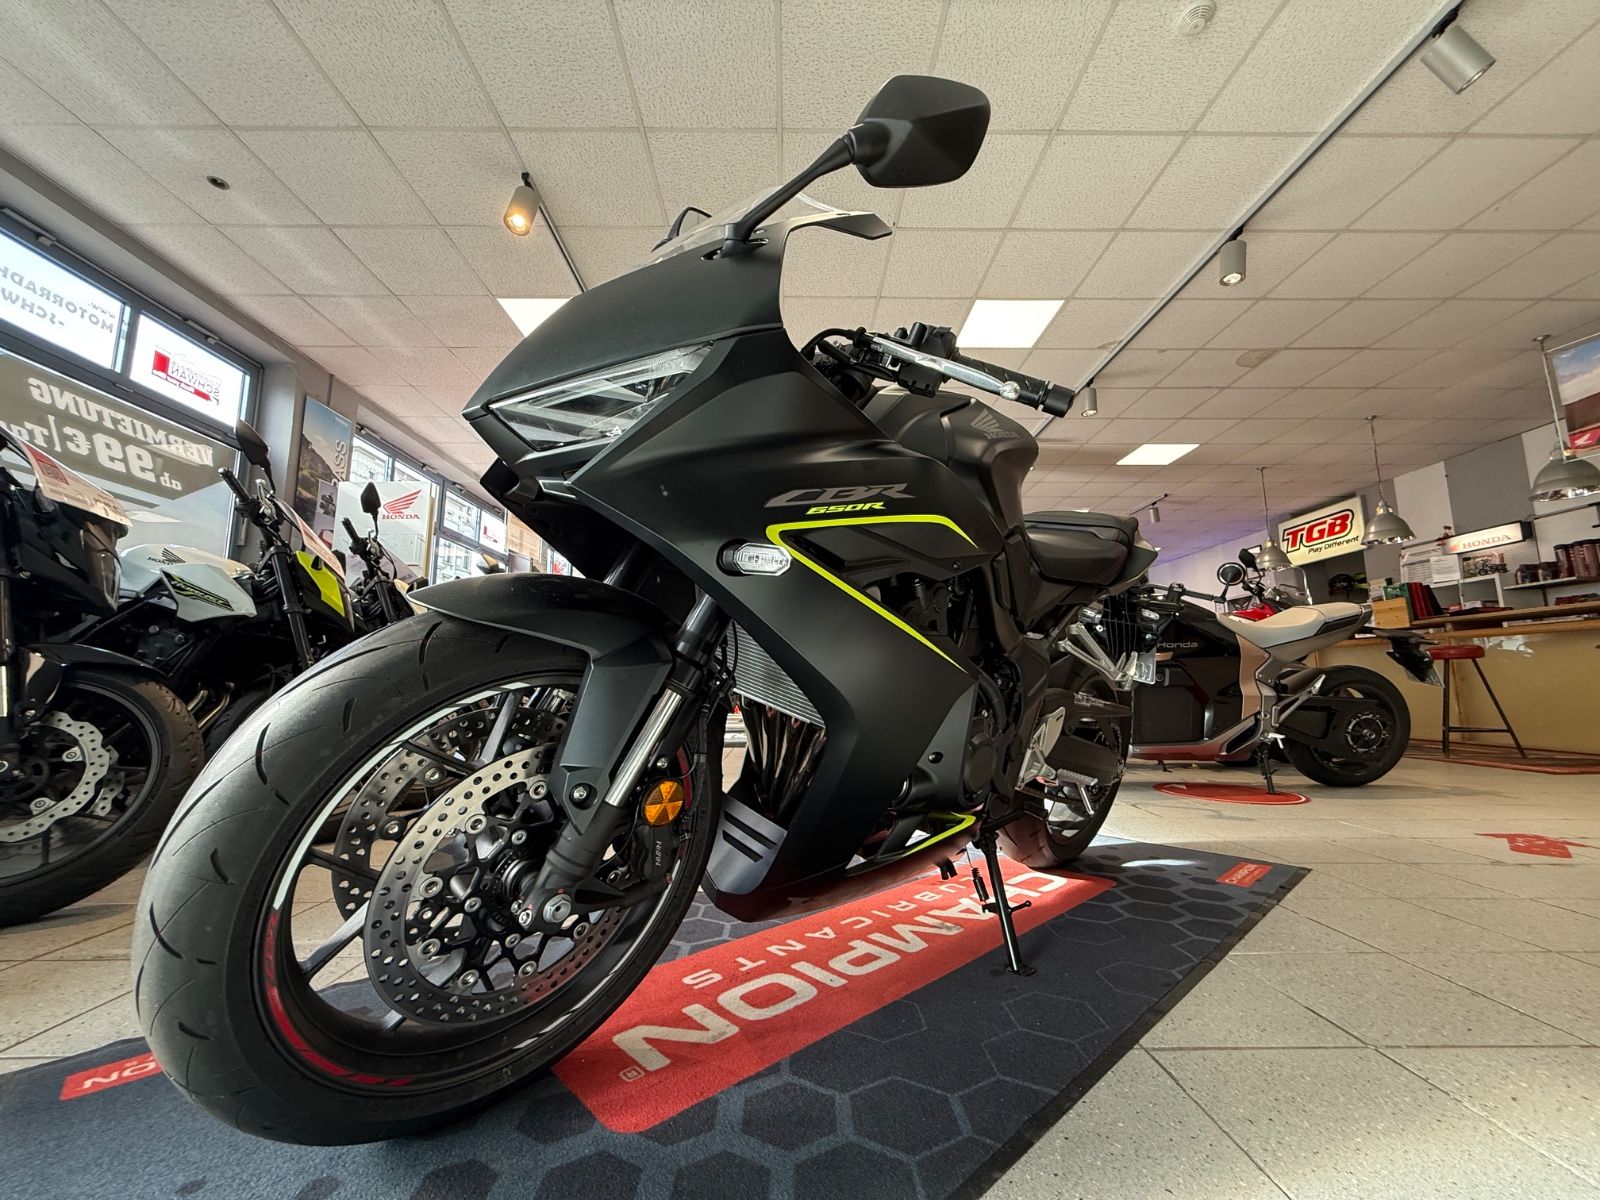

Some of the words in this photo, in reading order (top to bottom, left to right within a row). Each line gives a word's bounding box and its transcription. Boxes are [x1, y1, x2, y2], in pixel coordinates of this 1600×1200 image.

[764, 483, 915, 508] CBR
[805, 501, 887, 515] 650R
[1284, 510, 1352, 551] TGB
[1308, 546, 1323, 555] Play
[1324, 536, 1359, 550] Different
[1462, 534, 1511, 550] HONDA
[612, 871, 1068, 1072] CHAMPION
